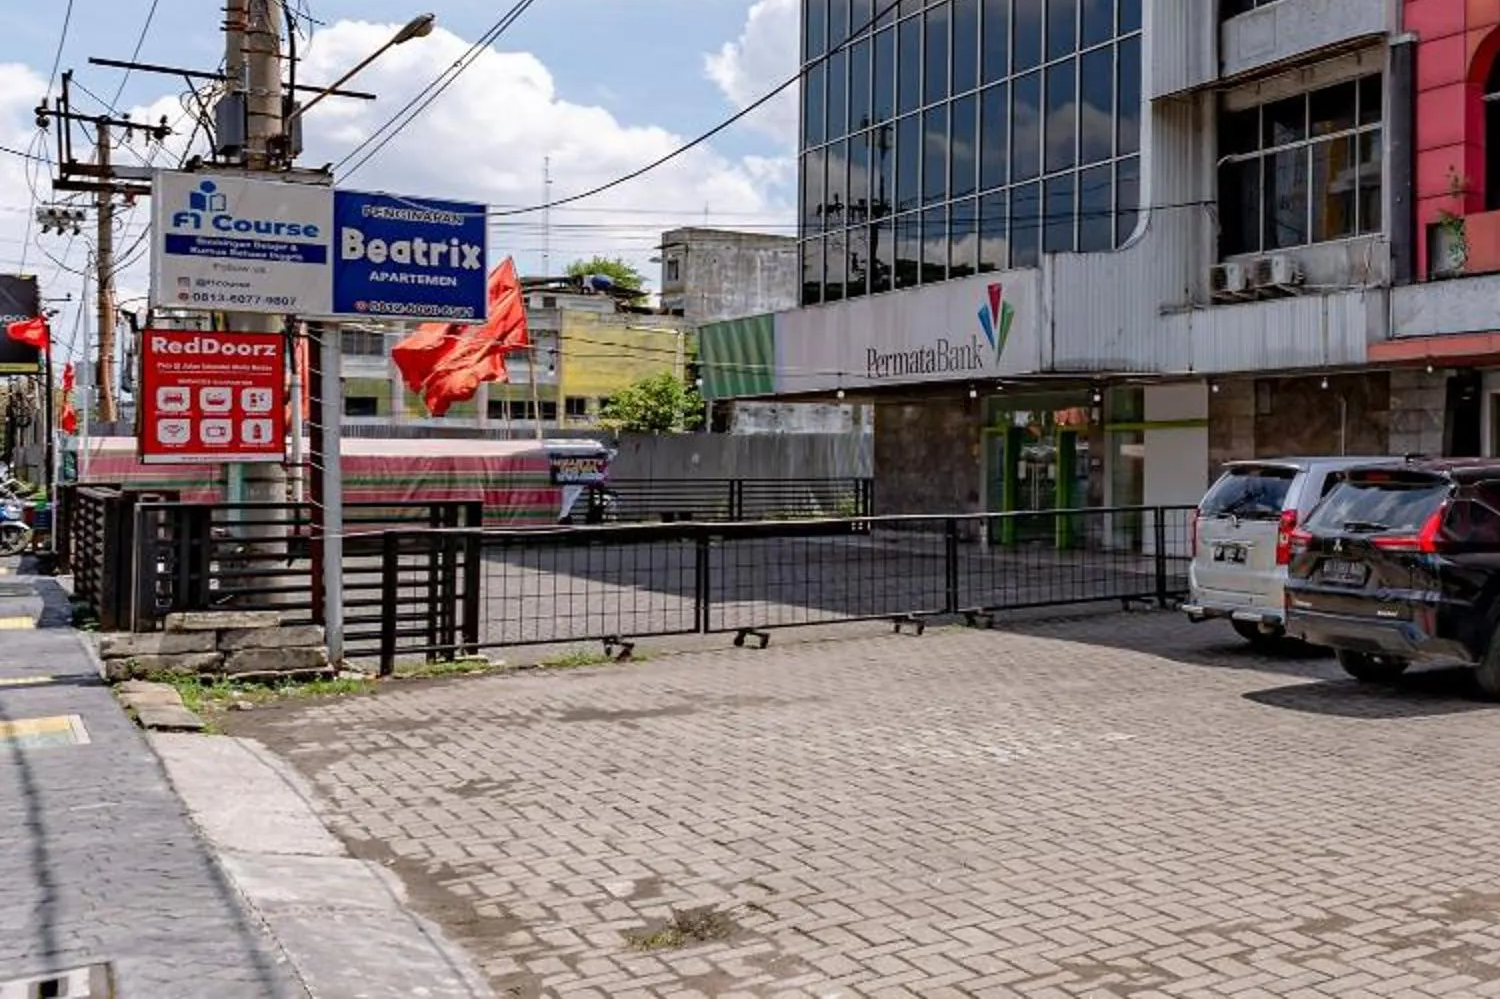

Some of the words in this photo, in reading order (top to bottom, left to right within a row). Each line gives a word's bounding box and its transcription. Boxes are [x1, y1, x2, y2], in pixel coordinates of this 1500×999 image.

[212, 214, 320, 238] Course
[341, 226, 482, 270] Beatrix
[369, 271, 457, 287] APARTEMEN
[151, 336, 277, 356] RedDoorz
[866, 334, 984, 379] PermataBank
